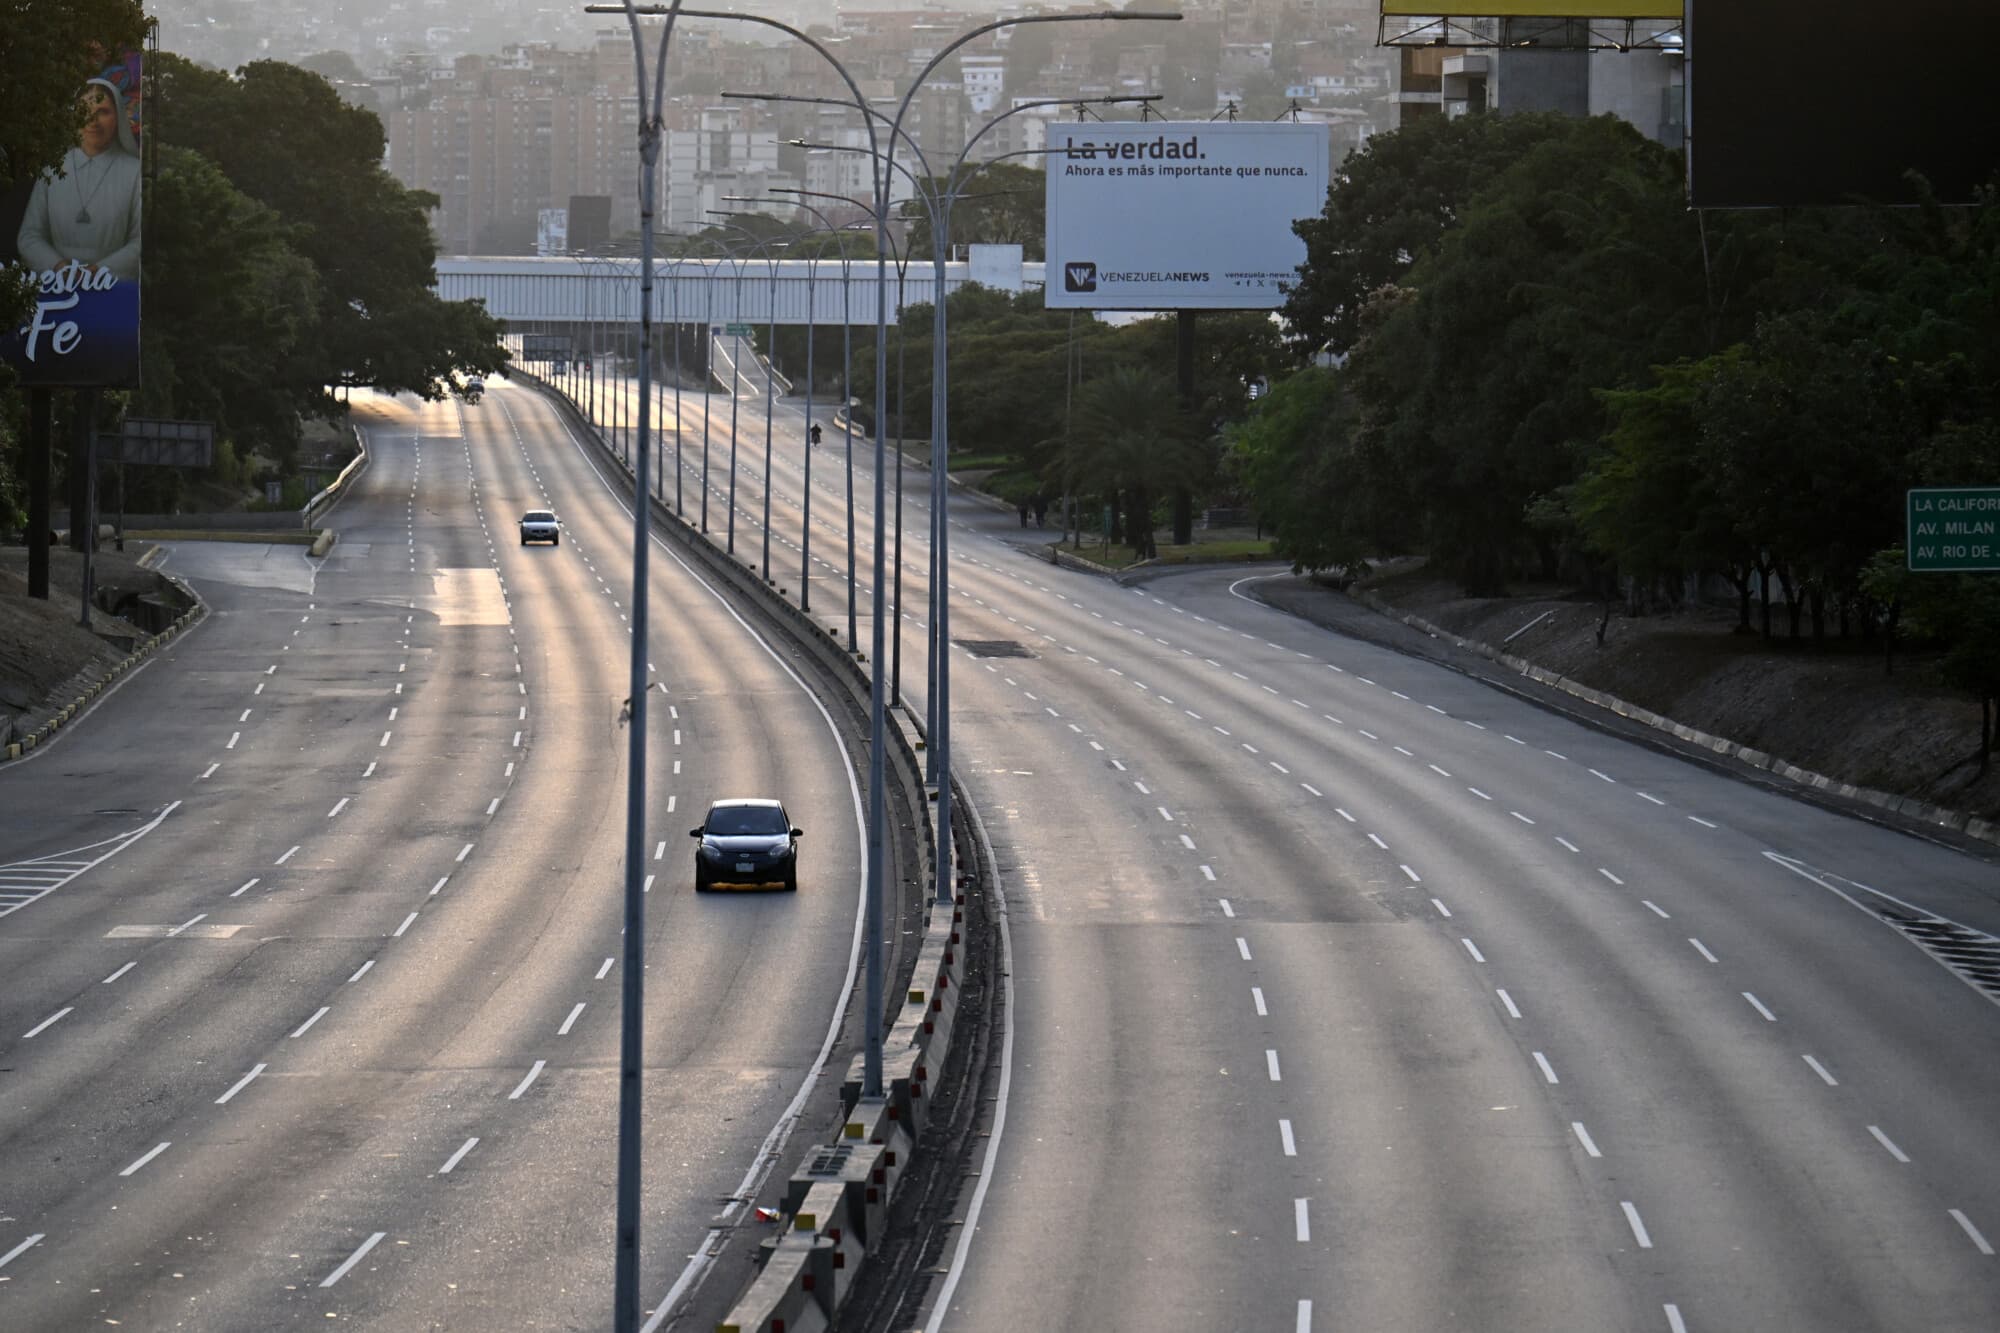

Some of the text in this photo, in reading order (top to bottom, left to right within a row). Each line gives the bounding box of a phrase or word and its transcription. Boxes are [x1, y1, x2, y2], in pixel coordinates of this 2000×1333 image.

[1067, 136, 1205, 160] La verdad.
[1065, 164, 1308, 179] Ahora es más importante que nunca.
[0, 259, 118, 294] uestra
[1100, 272, 1210, 282] VENEZUELANEWS
[1225, 271, 1301, 279] venezuela-news.co
[20, 291, 82, 362] Fe
[1915, 498, 2000, 512] LA CALIFOR
[1916, 521, 1995, 535] AV. MILAN
[1917, 546, 1937, 559] AV.
[1942, 545, 1967, 558] RIO
[1971, 545, 1991, 558] DE
